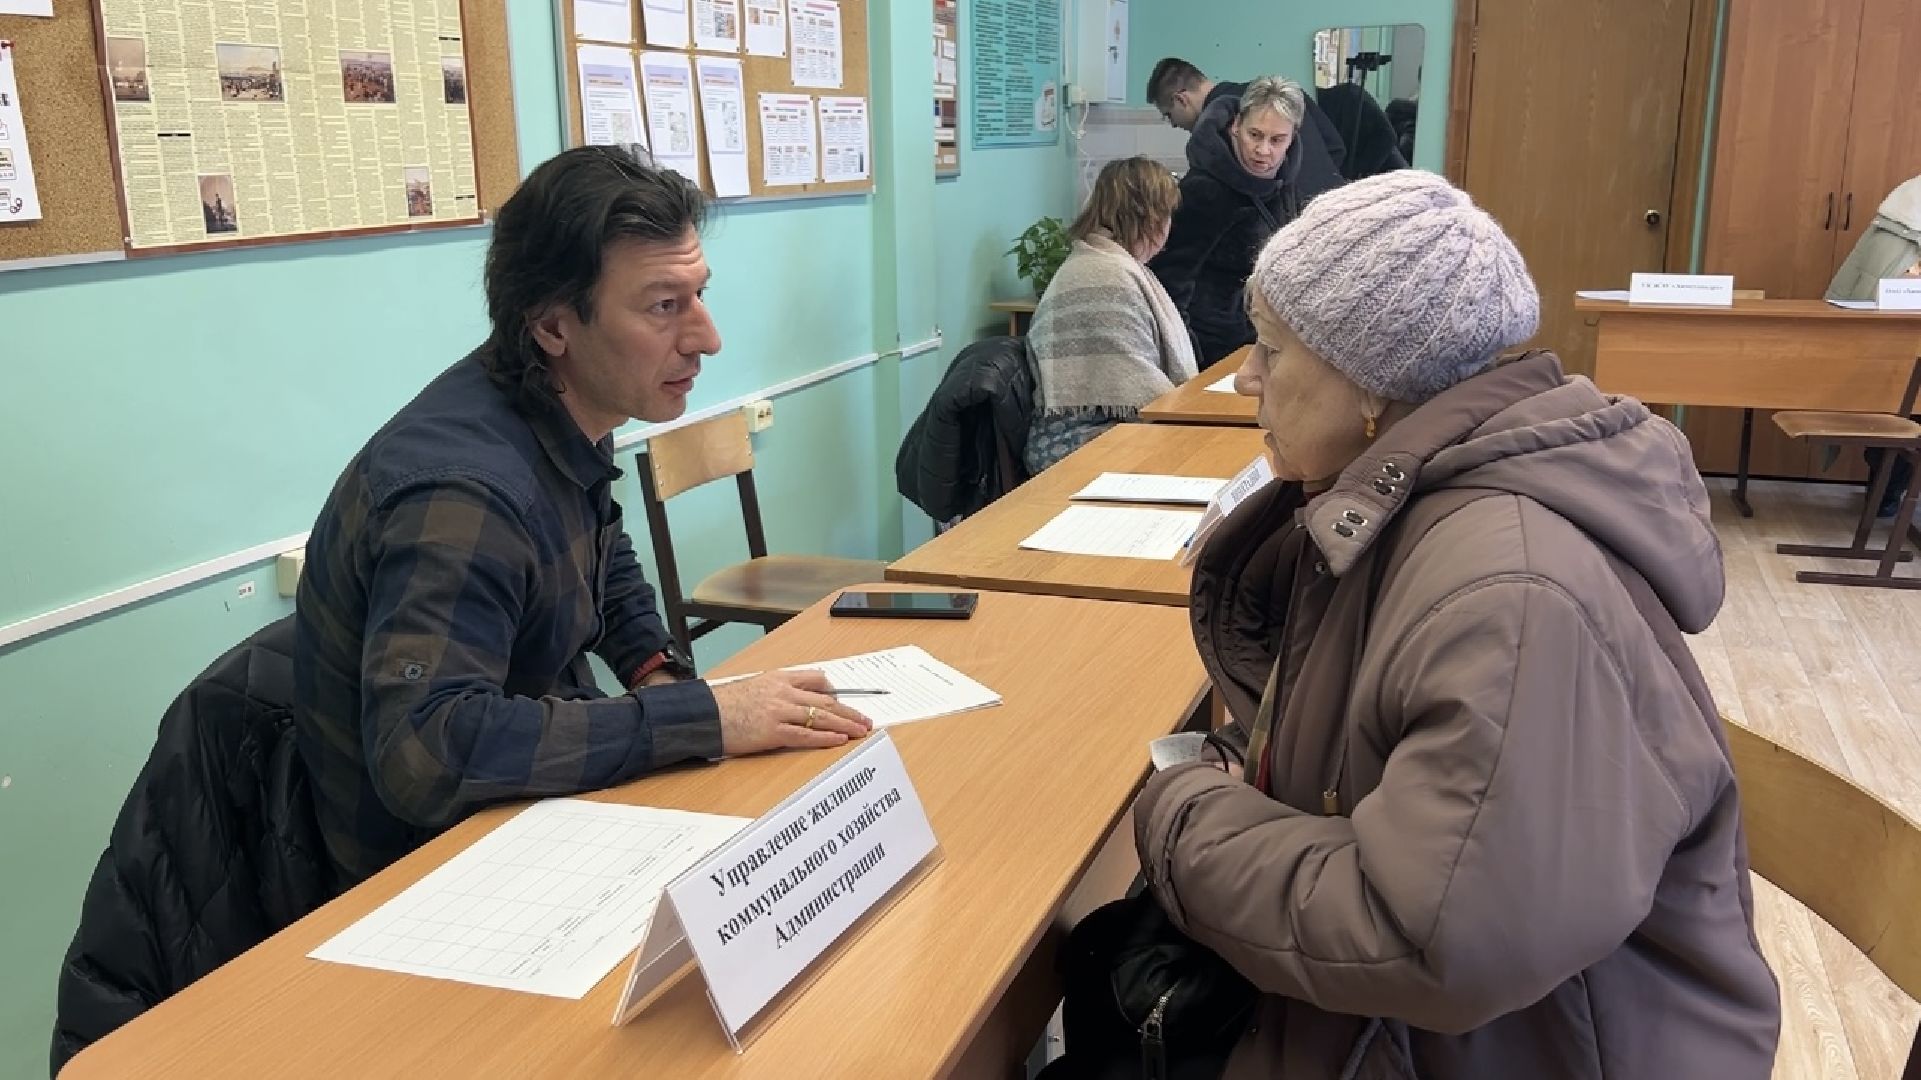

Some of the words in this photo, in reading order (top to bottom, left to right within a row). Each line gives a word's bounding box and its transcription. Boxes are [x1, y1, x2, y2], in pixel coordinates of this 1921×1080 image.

[710, 815, 808, 897] Управление
[807, 767, 876, 825] жилищно-
[717, 839, 837, 946] коммунального
[837, 787, 902, 848] хозяйства
[775, 842, 886, 949] Администрации
